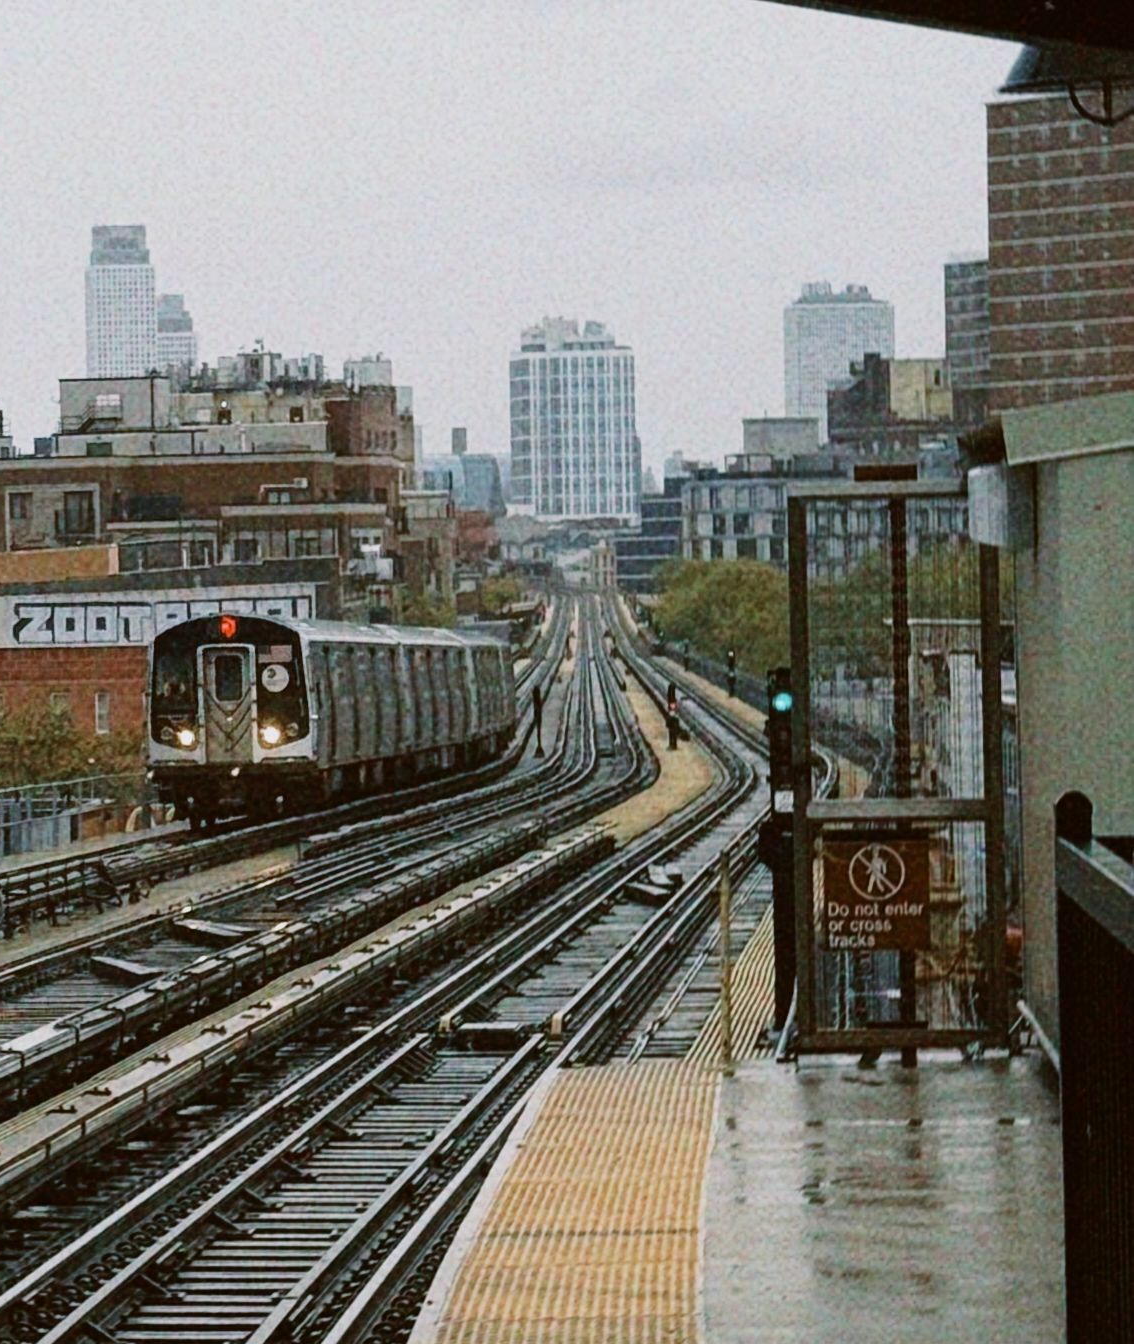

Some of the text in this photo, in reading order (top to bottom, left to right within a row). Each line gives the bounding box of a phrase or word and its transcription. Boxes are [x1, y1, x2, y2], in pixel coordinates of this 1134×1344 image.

[12, 601, 152, 644] ZOOT
[827, 900, 924, 917] Do not enter
[828, 919, 892, 933] or cross
[828, 933, 876, 948] tracks
